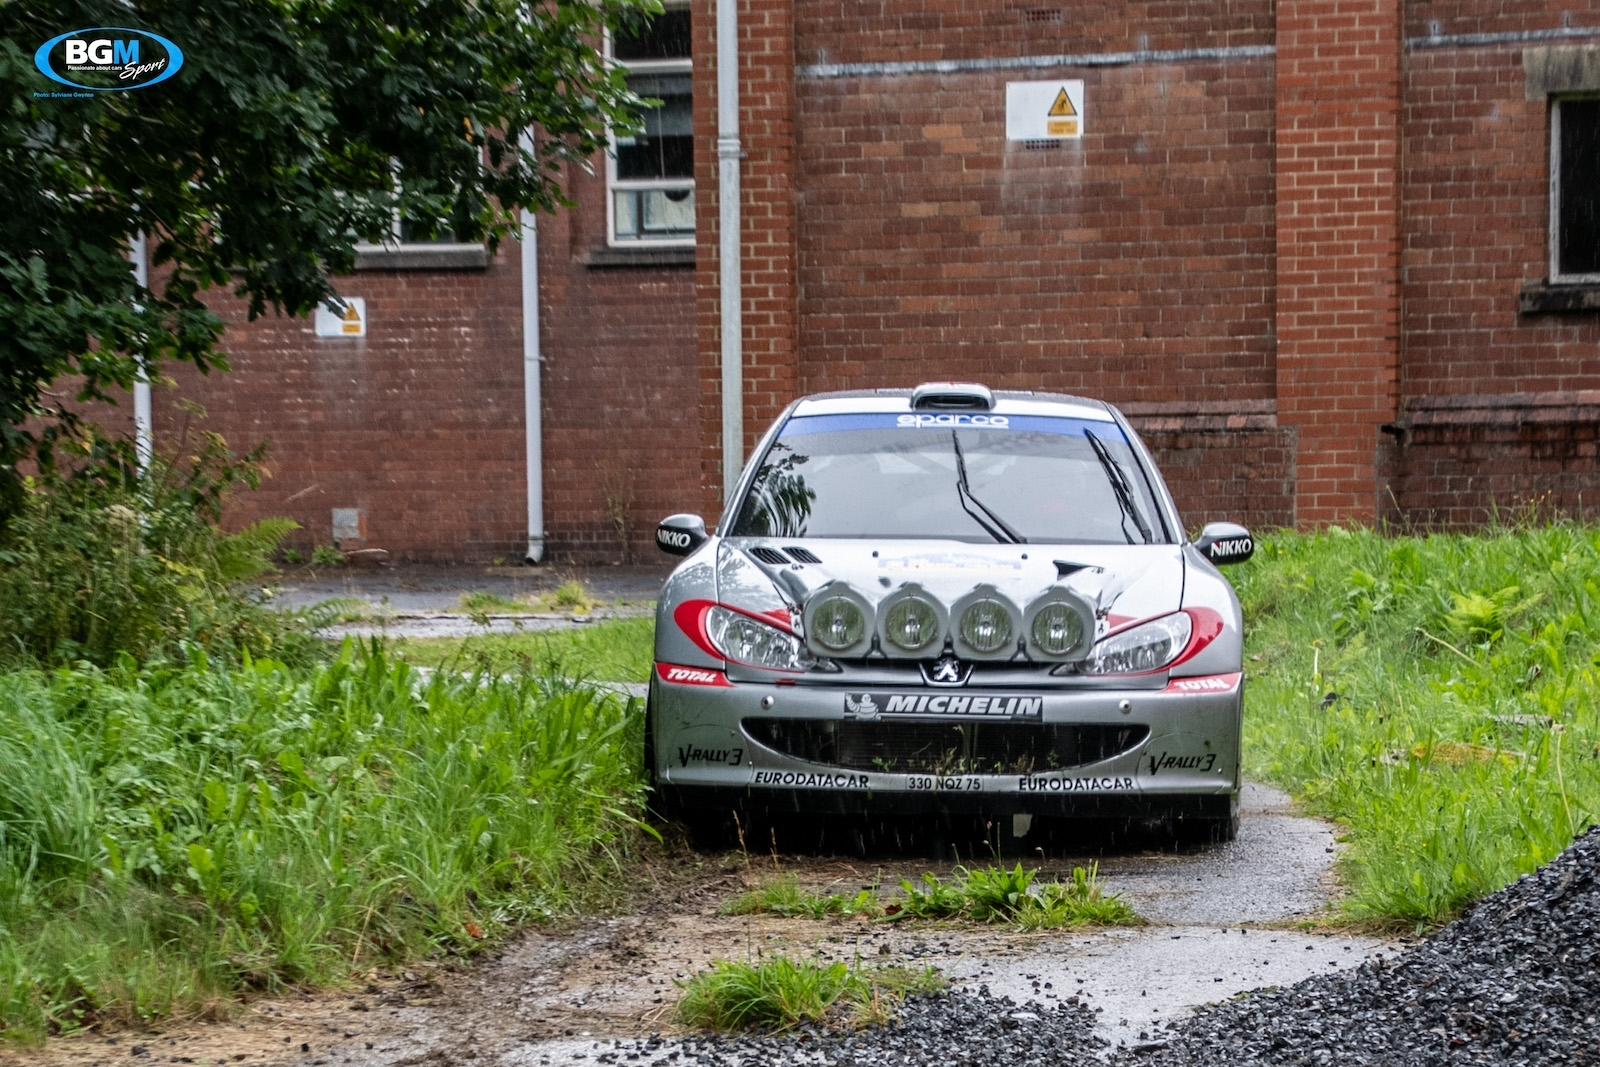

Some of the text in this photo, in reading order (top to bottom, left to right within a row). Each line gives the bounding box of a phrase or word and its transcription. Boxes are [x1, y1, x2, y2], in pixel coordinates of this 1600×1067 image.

[657, 529, 691, 547] NIKKO
[1211, 538, 1252, 557] NIKKO
[667, 668, 717, 682] TOTAL
[1174, 678, 1230, 690] TOTAL
[885, 695, 1041, 714] MICHELIN
[755, 771, 870, 788] EURODATACAR
[909, 777, 981, 790] 330 NQZ 75
[1019, 777, 1134, 790] EURODATACAR
